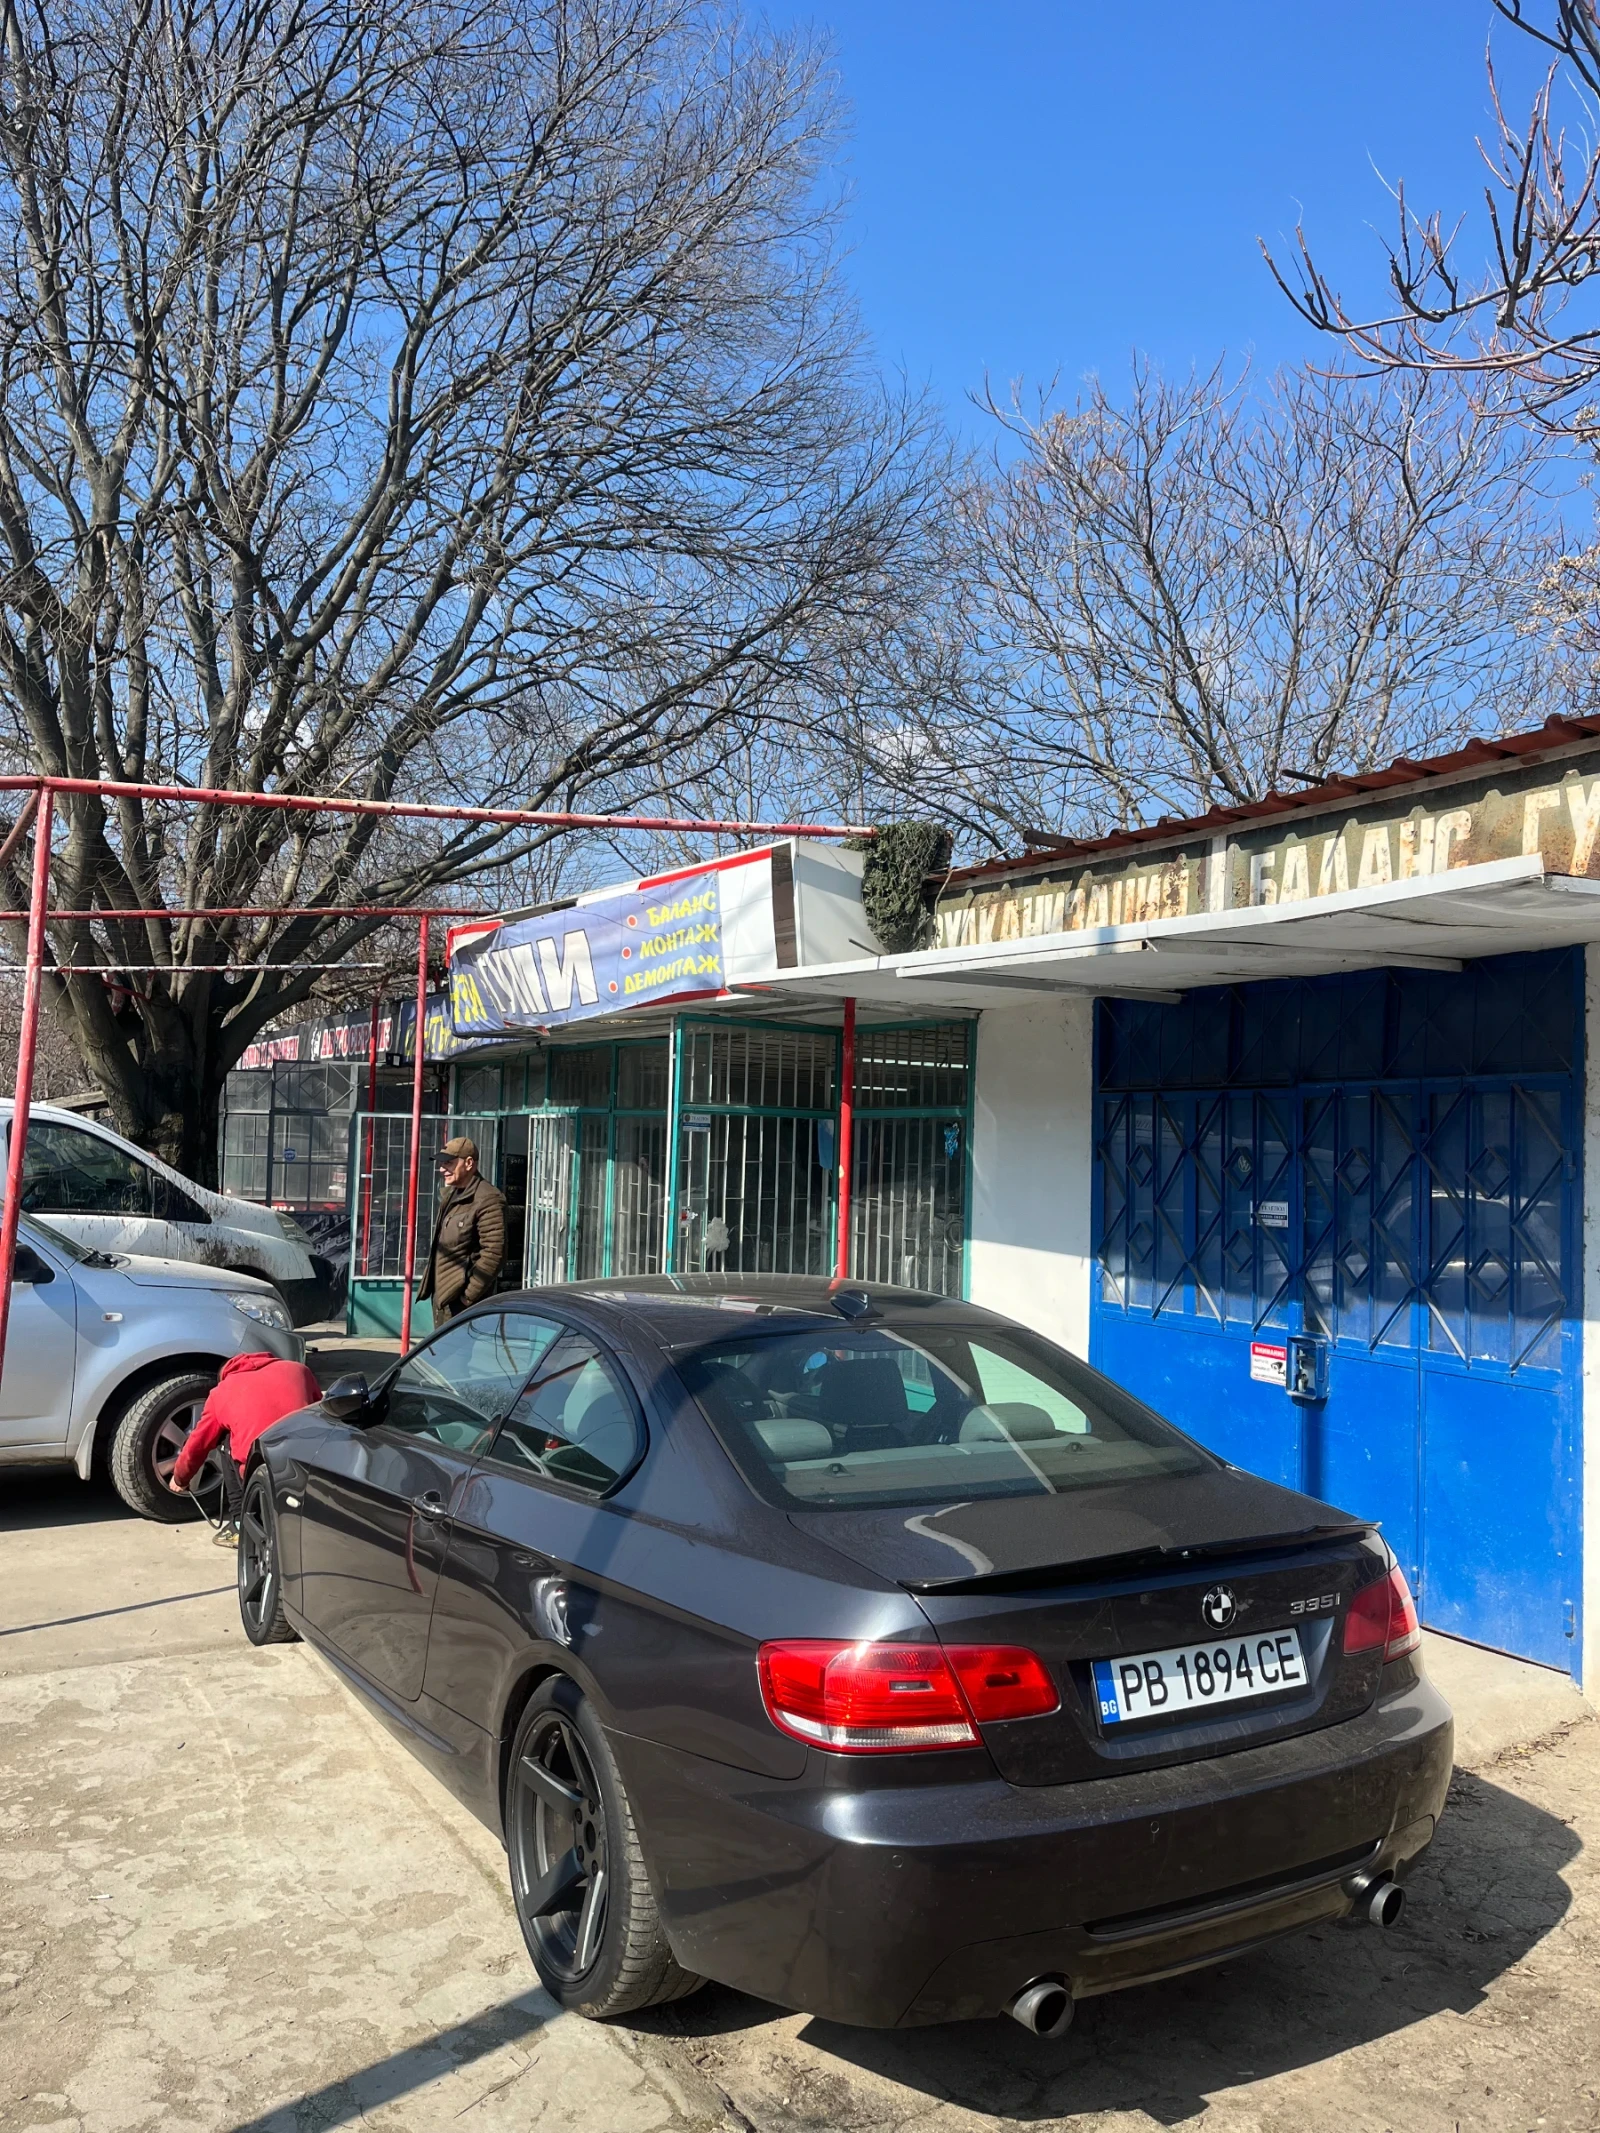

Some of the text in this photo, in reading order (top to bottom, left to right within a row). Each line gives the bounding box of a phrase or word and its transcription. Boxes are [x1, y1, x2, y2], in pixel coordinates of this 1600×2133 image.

[1249, 809, 1472, 907] БАЛАНС
[646, 891, 716, 927] БАЛАНС
[640, 923, 718, 959] МОНТАЖ
[624, 954, 721, 995] ДЕМОНТАЖ
[320, 1016, 393, 1060] АВТОСЕРИЗ
[1207, 1586, 1234, 1604] BMW
[1119, 1635, 1300, 1711] PB 1894 CE
[1101, 1700, 1118, 1716] BG
